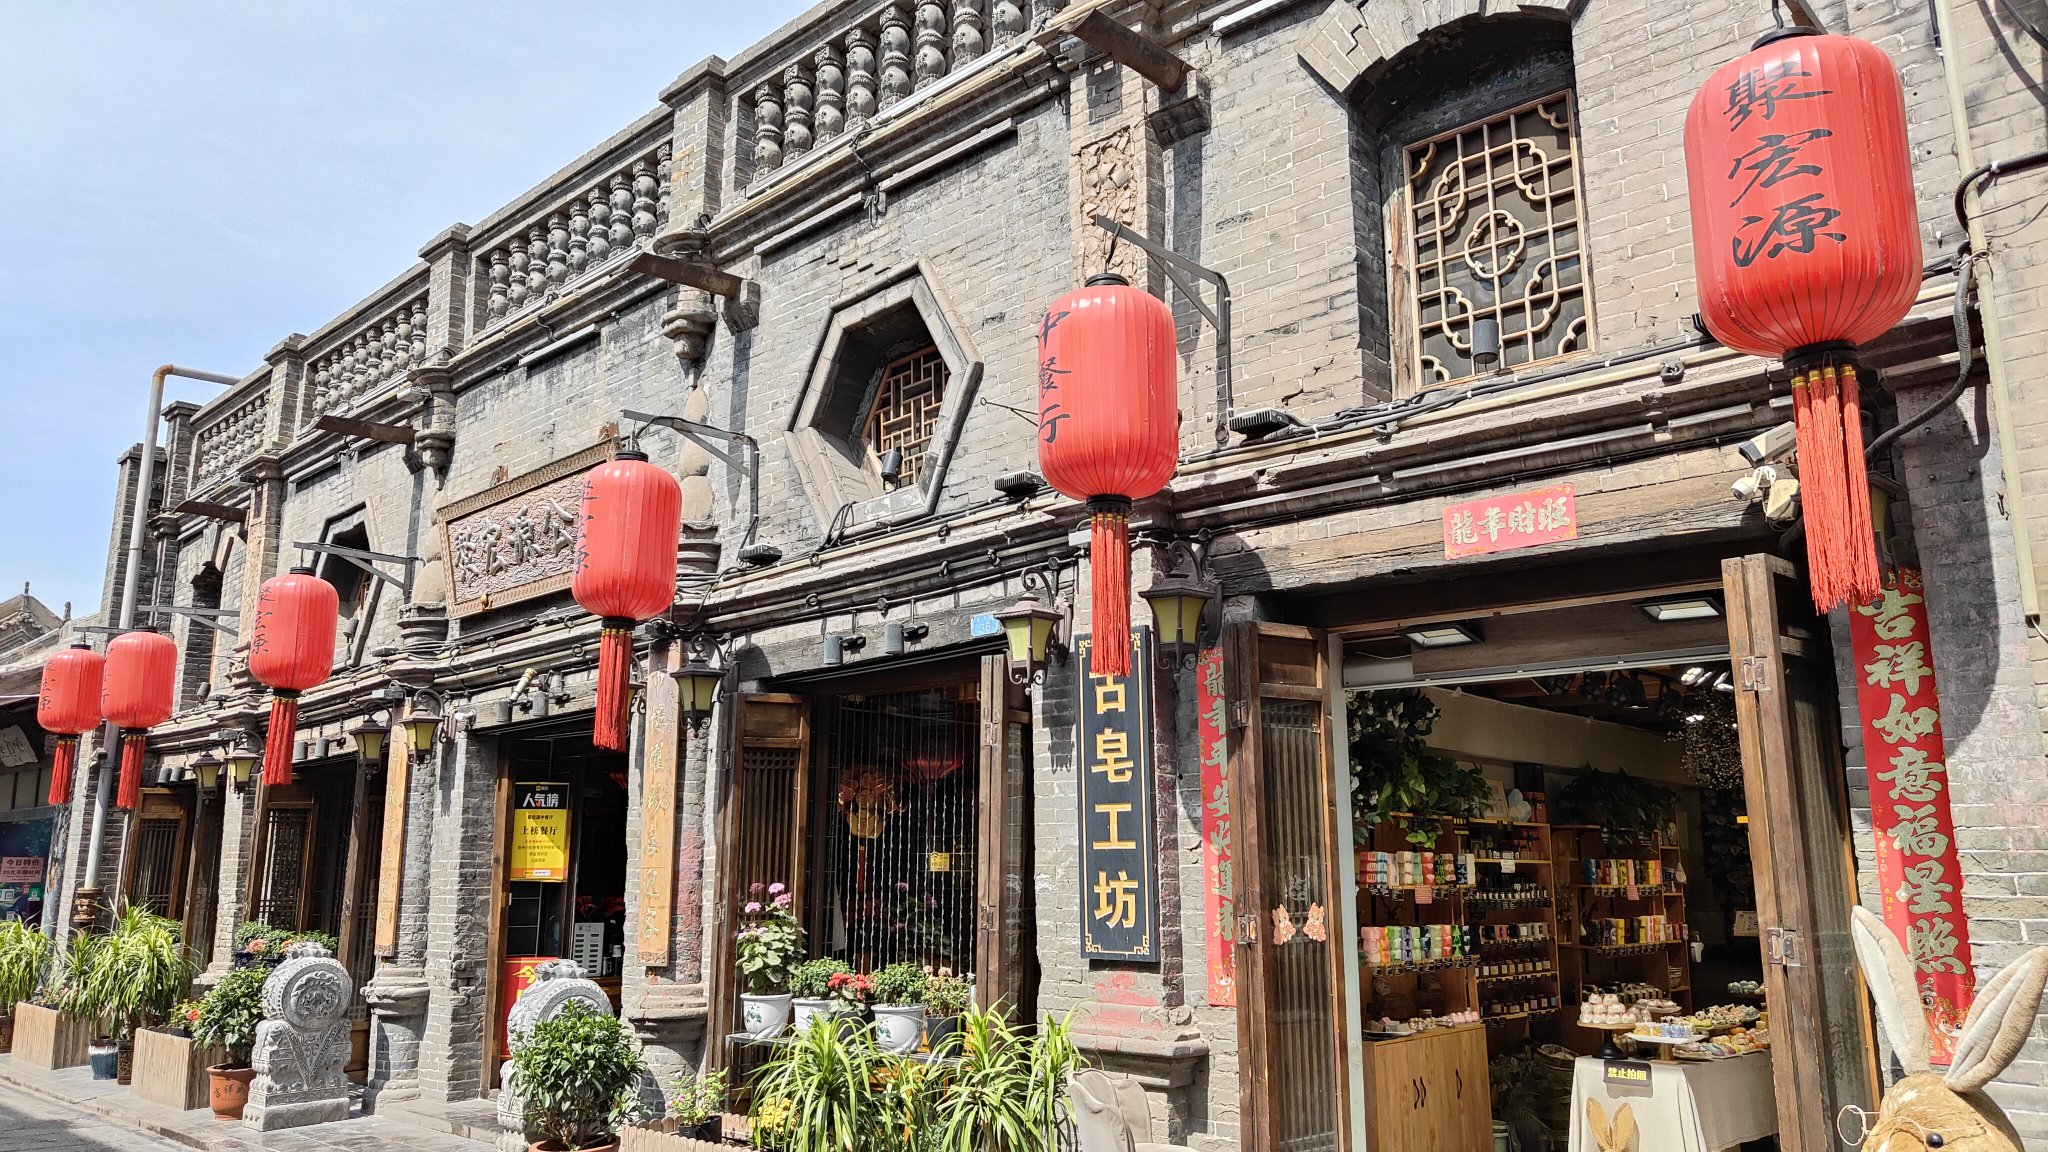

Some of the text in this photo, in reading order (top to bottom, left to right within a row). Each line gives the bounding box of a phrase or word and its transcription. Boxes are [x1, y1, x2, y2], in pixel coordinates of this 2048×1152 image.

[1723, 62, 1847, 267] 聚宏源
[1858, 588, 1967, 975] 吉祥如意福星照
[522, 792, 559, 807] 人气榜
[521, 825, 558, 836] 上榜餐厅
[6, 858, 40, 867] 今日特价
[1607, 1066, 1648, 1081] 禁止拍照
